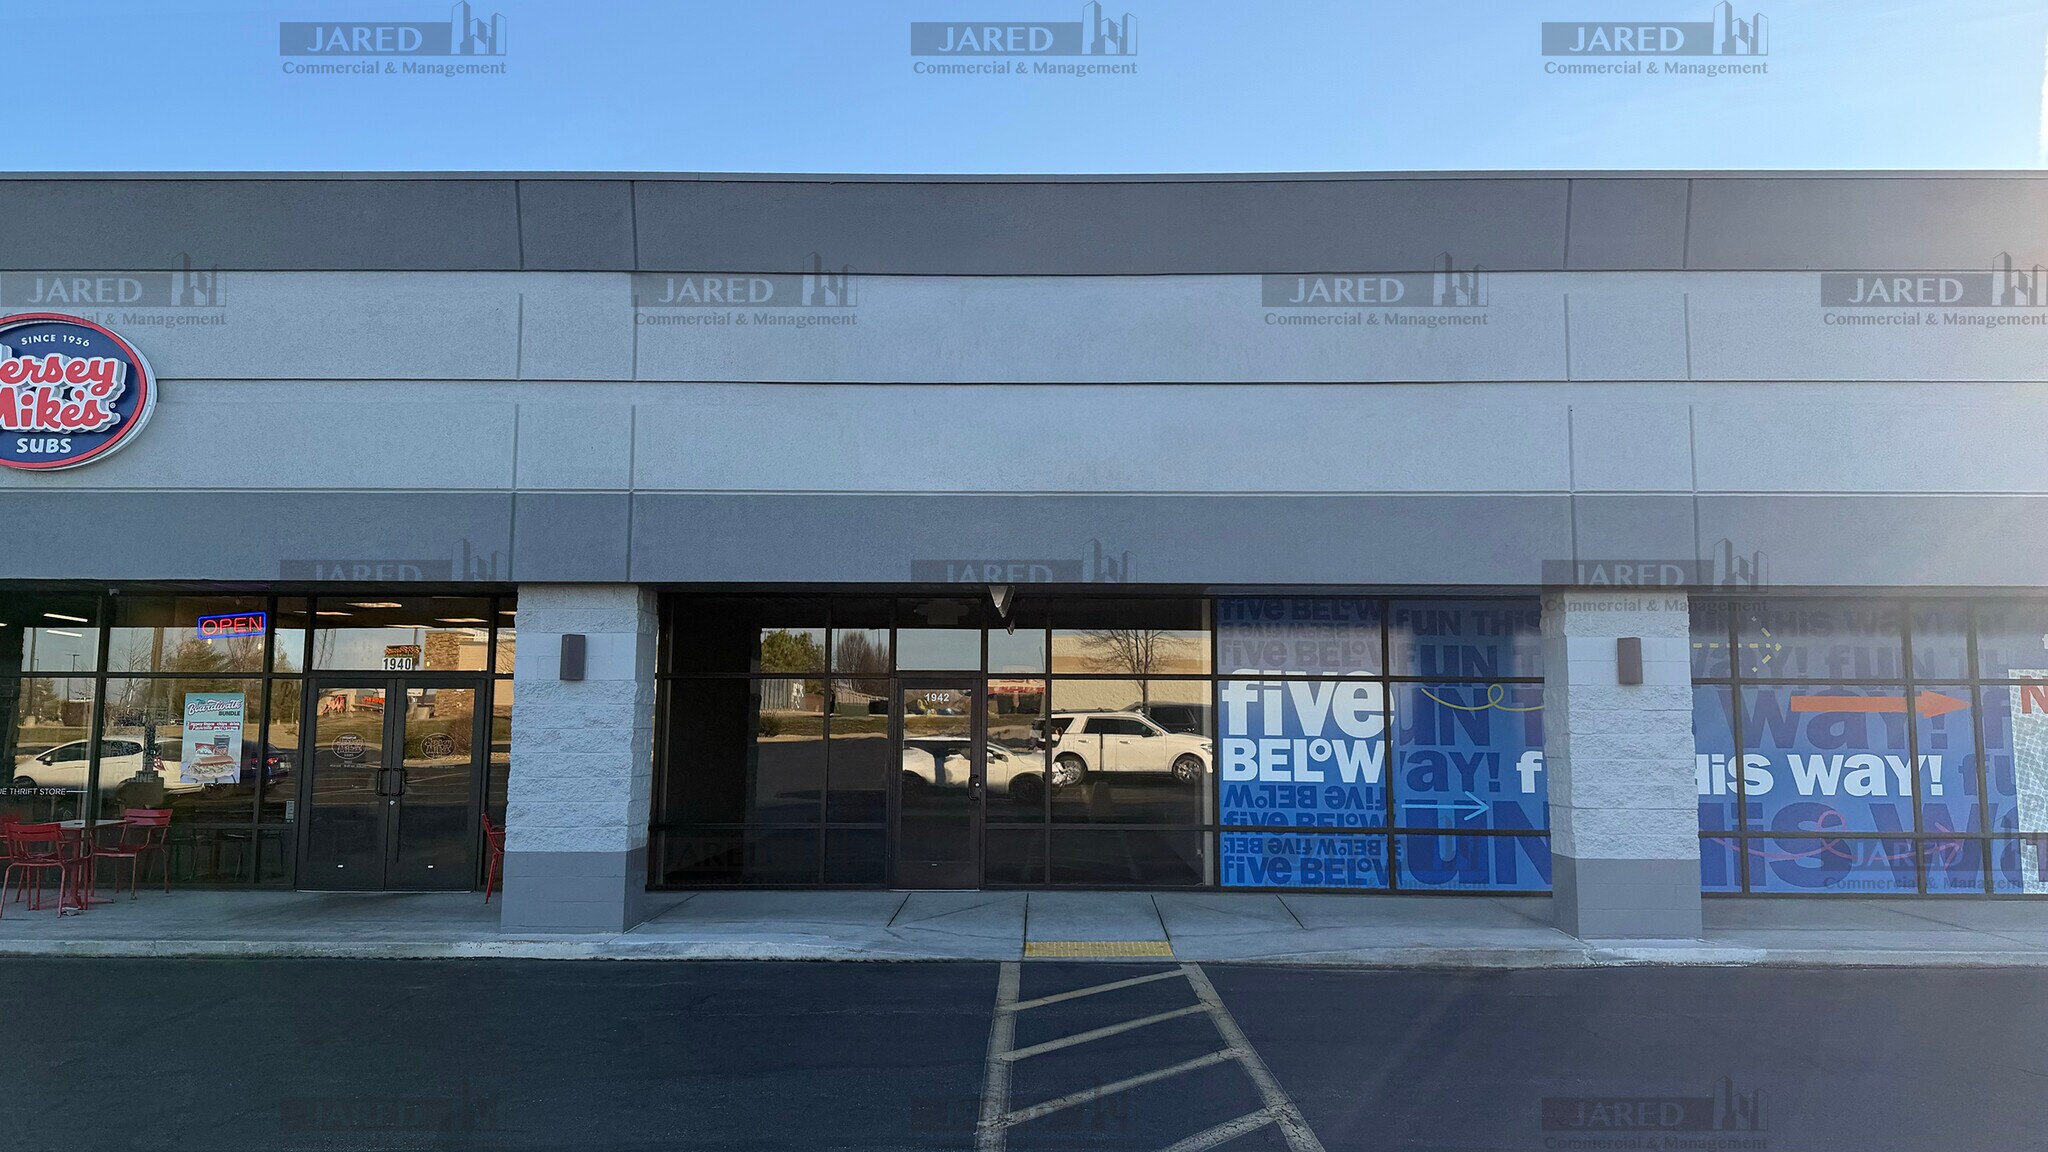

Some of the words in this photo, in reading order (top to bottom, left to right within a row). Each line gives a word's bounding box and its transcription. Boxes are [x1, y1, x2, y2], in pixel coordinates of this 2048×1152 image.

[21, 334, 56, 346] SINCE
[62, 334, 90, 347] 1956
[0, 354, 117, 397] ersey
[16, 438, 71, 454] SUBS
[202, 616, 262, 635] OPEN
[1221, 640, 1288, 667] five
[383, 658, 412, 670] 1940
[925, 693, 950, 702] 1942
[1222, 669, 1395, 739] five
[10, 788, 38, 796] THRIFT
[39, 788, 66, 796] STORE
